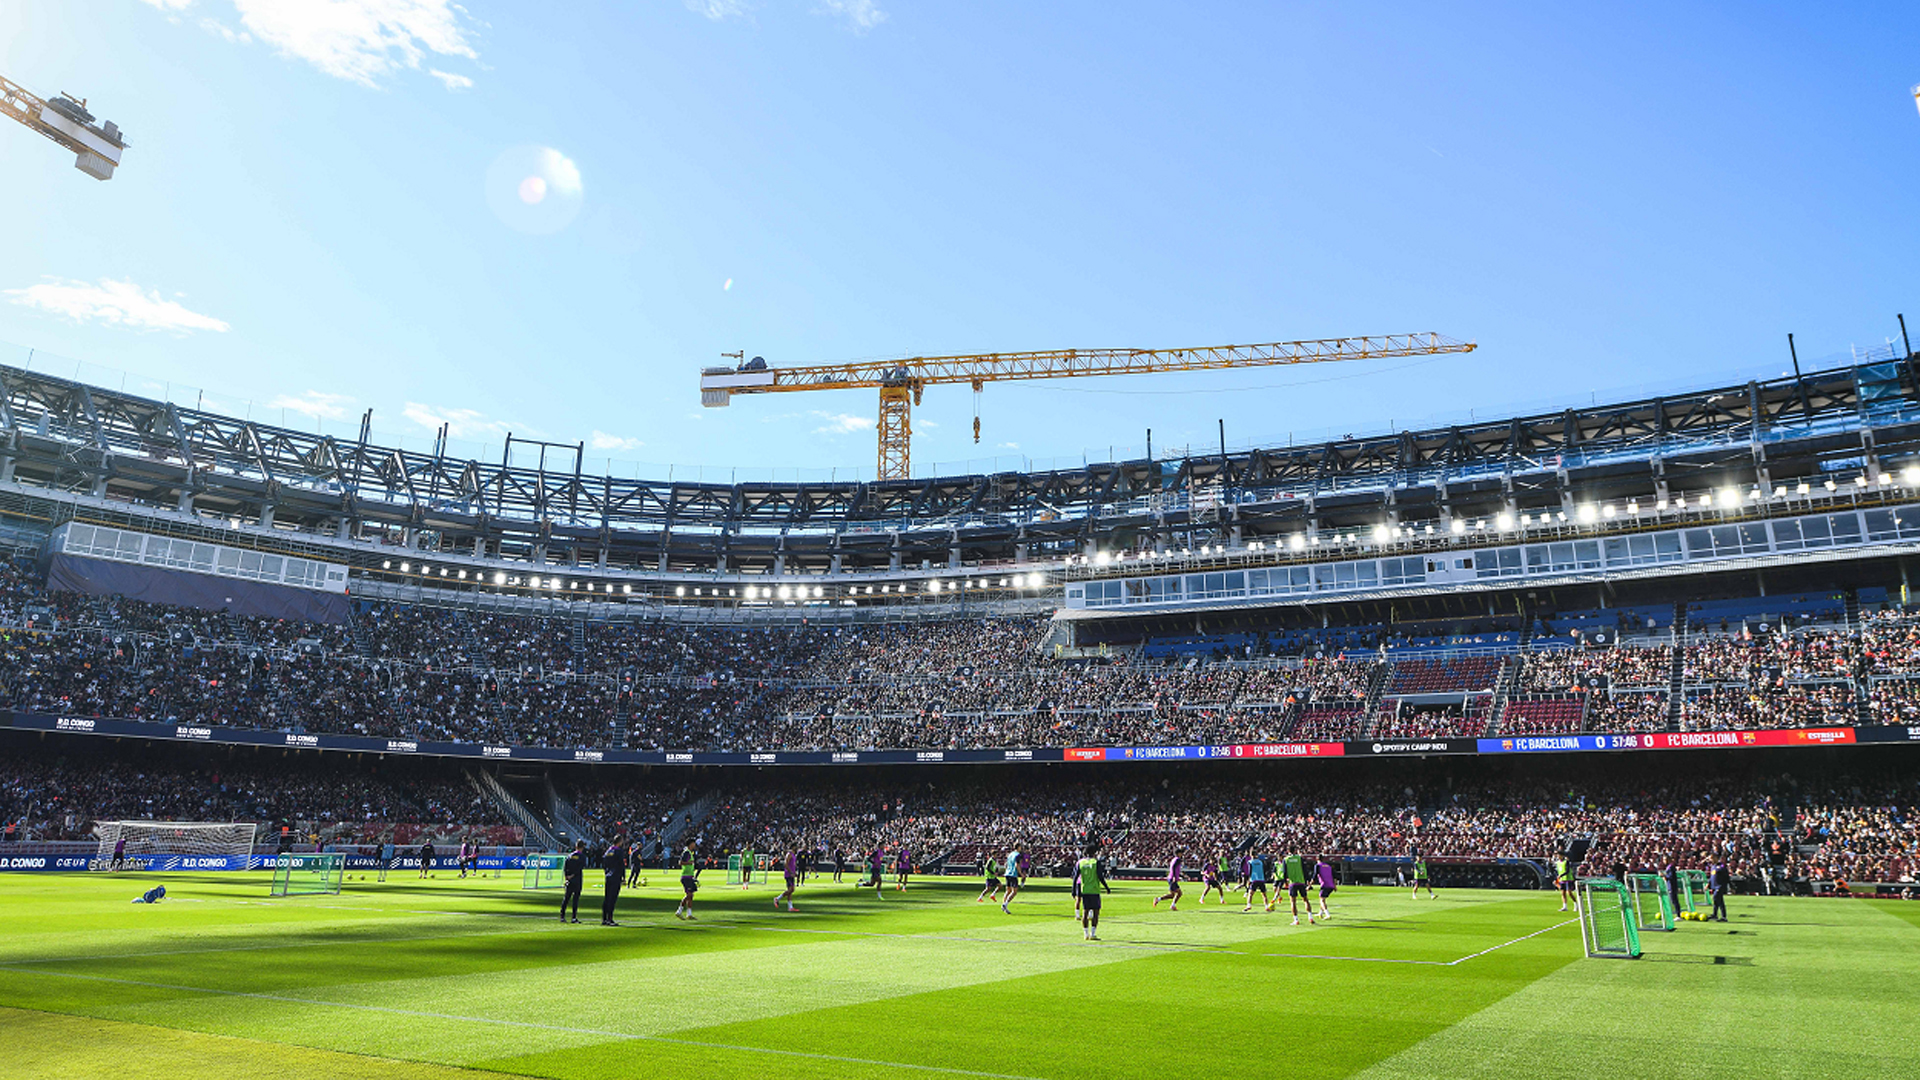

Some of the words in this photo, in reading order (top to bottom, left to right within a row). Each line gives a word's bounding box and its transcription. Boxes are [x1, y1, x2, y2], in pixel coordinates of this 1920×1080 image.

[1668, 735, 1680, 745] FC
[1681, 733, 1739, 745] BARCELONA
[1807, 731, 1845, 739] ESTRELLA
[1516, 739, 1527, 750] FC
[1528, 737, 1579, 750] BARCELONA
[1595, 736, 1605, 748] 0
[1643, 735, 1654, 747] 0
[1198, 746, 1206, 756] 0
[1235, 745, 1243, 755] 0
[1254, 745, 1263, 755] FC
[1263, 744, 1307, 755] BARCELONA
[1411, 743, 1431, 751] CAMP
[1136, 749, 1145, 758] FC
[1146, 748, 1186, 758] BARCELONA
[10, 858, 46, 867] CONGO
[56, 858, 86, 867] CŒUR
[182, 858, 197, 867] R.D.
[197, 858, 227, 867] CONGO
[263, 858, 277, 867] R.D.
